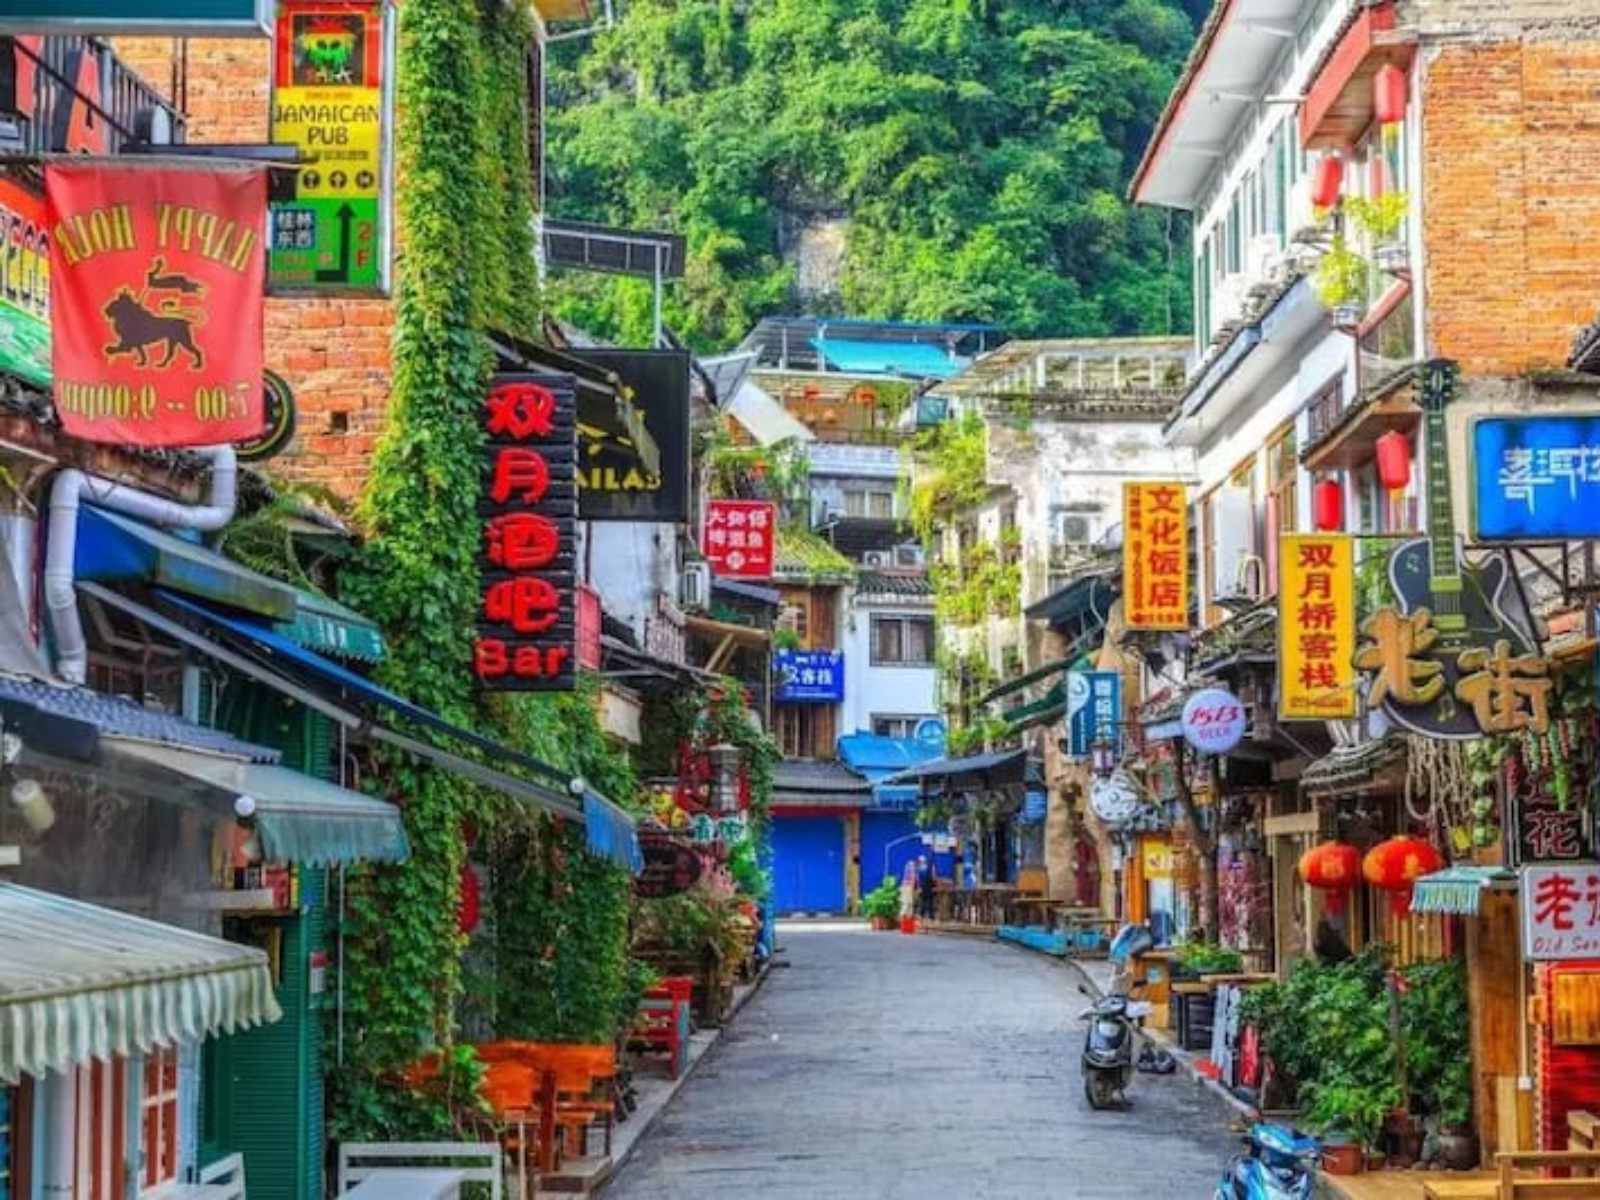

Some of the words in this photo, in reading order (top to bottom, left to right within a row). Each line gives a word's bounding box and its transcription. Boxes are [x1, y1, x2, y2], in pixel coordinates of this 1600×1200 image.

[275, 104, 379, 122] JAMAICAN
[307, 126, 348, 145] PUB
[484, 382, 559, 633] 双月酒吧
[1146, 486, 1181, 608] 文化饭店
[1297, 543, 1337, 689] 双月桥客栈
[475, 639, 566, 677] Bar
